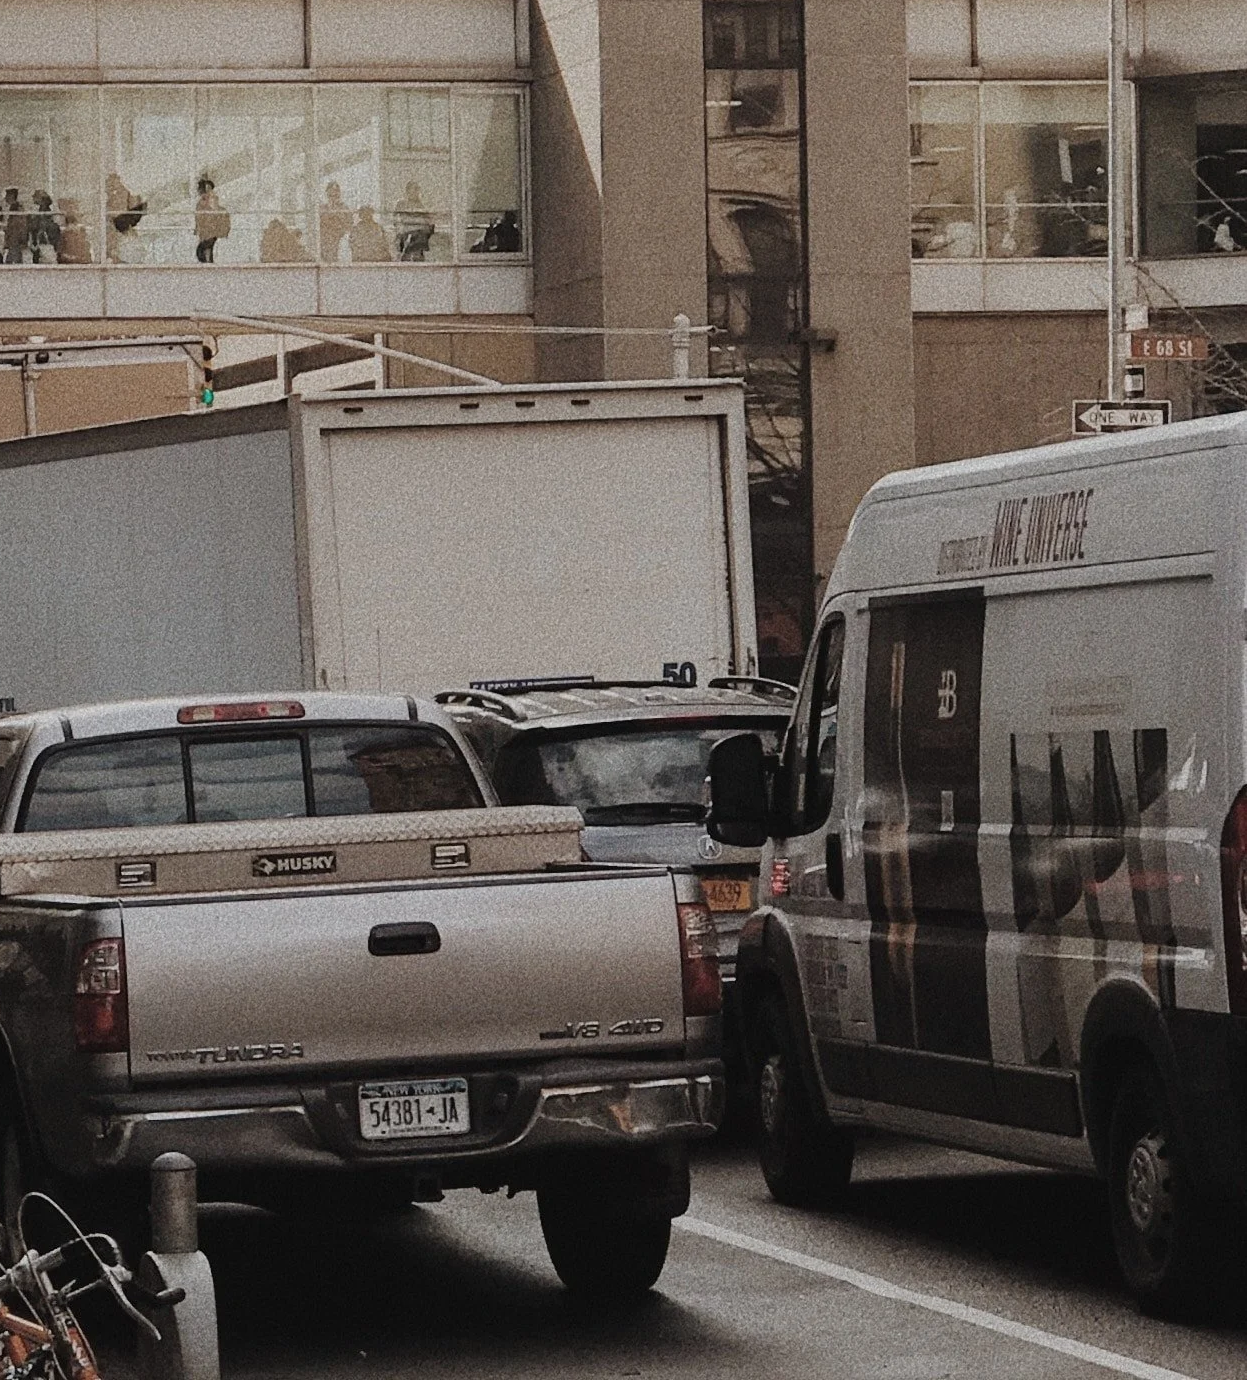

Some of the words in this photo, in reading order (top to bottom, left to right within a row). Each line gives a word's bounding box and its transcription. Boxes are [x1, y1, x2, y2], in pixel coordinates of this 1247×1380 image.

[1143, 341, 1150, 356] E
[1156, 340, 1174, 356] 68
[1089, 412, 1115, 424] ONE
[1129, 412, 1157, 424] WAY
[1024, 488, 1094, 564] UNIVERSE
[662, 661, 698, 688] 50
[277, 855, 334, 872] HUSKY
[196, 1042, 304, 1064] TUNDRA
